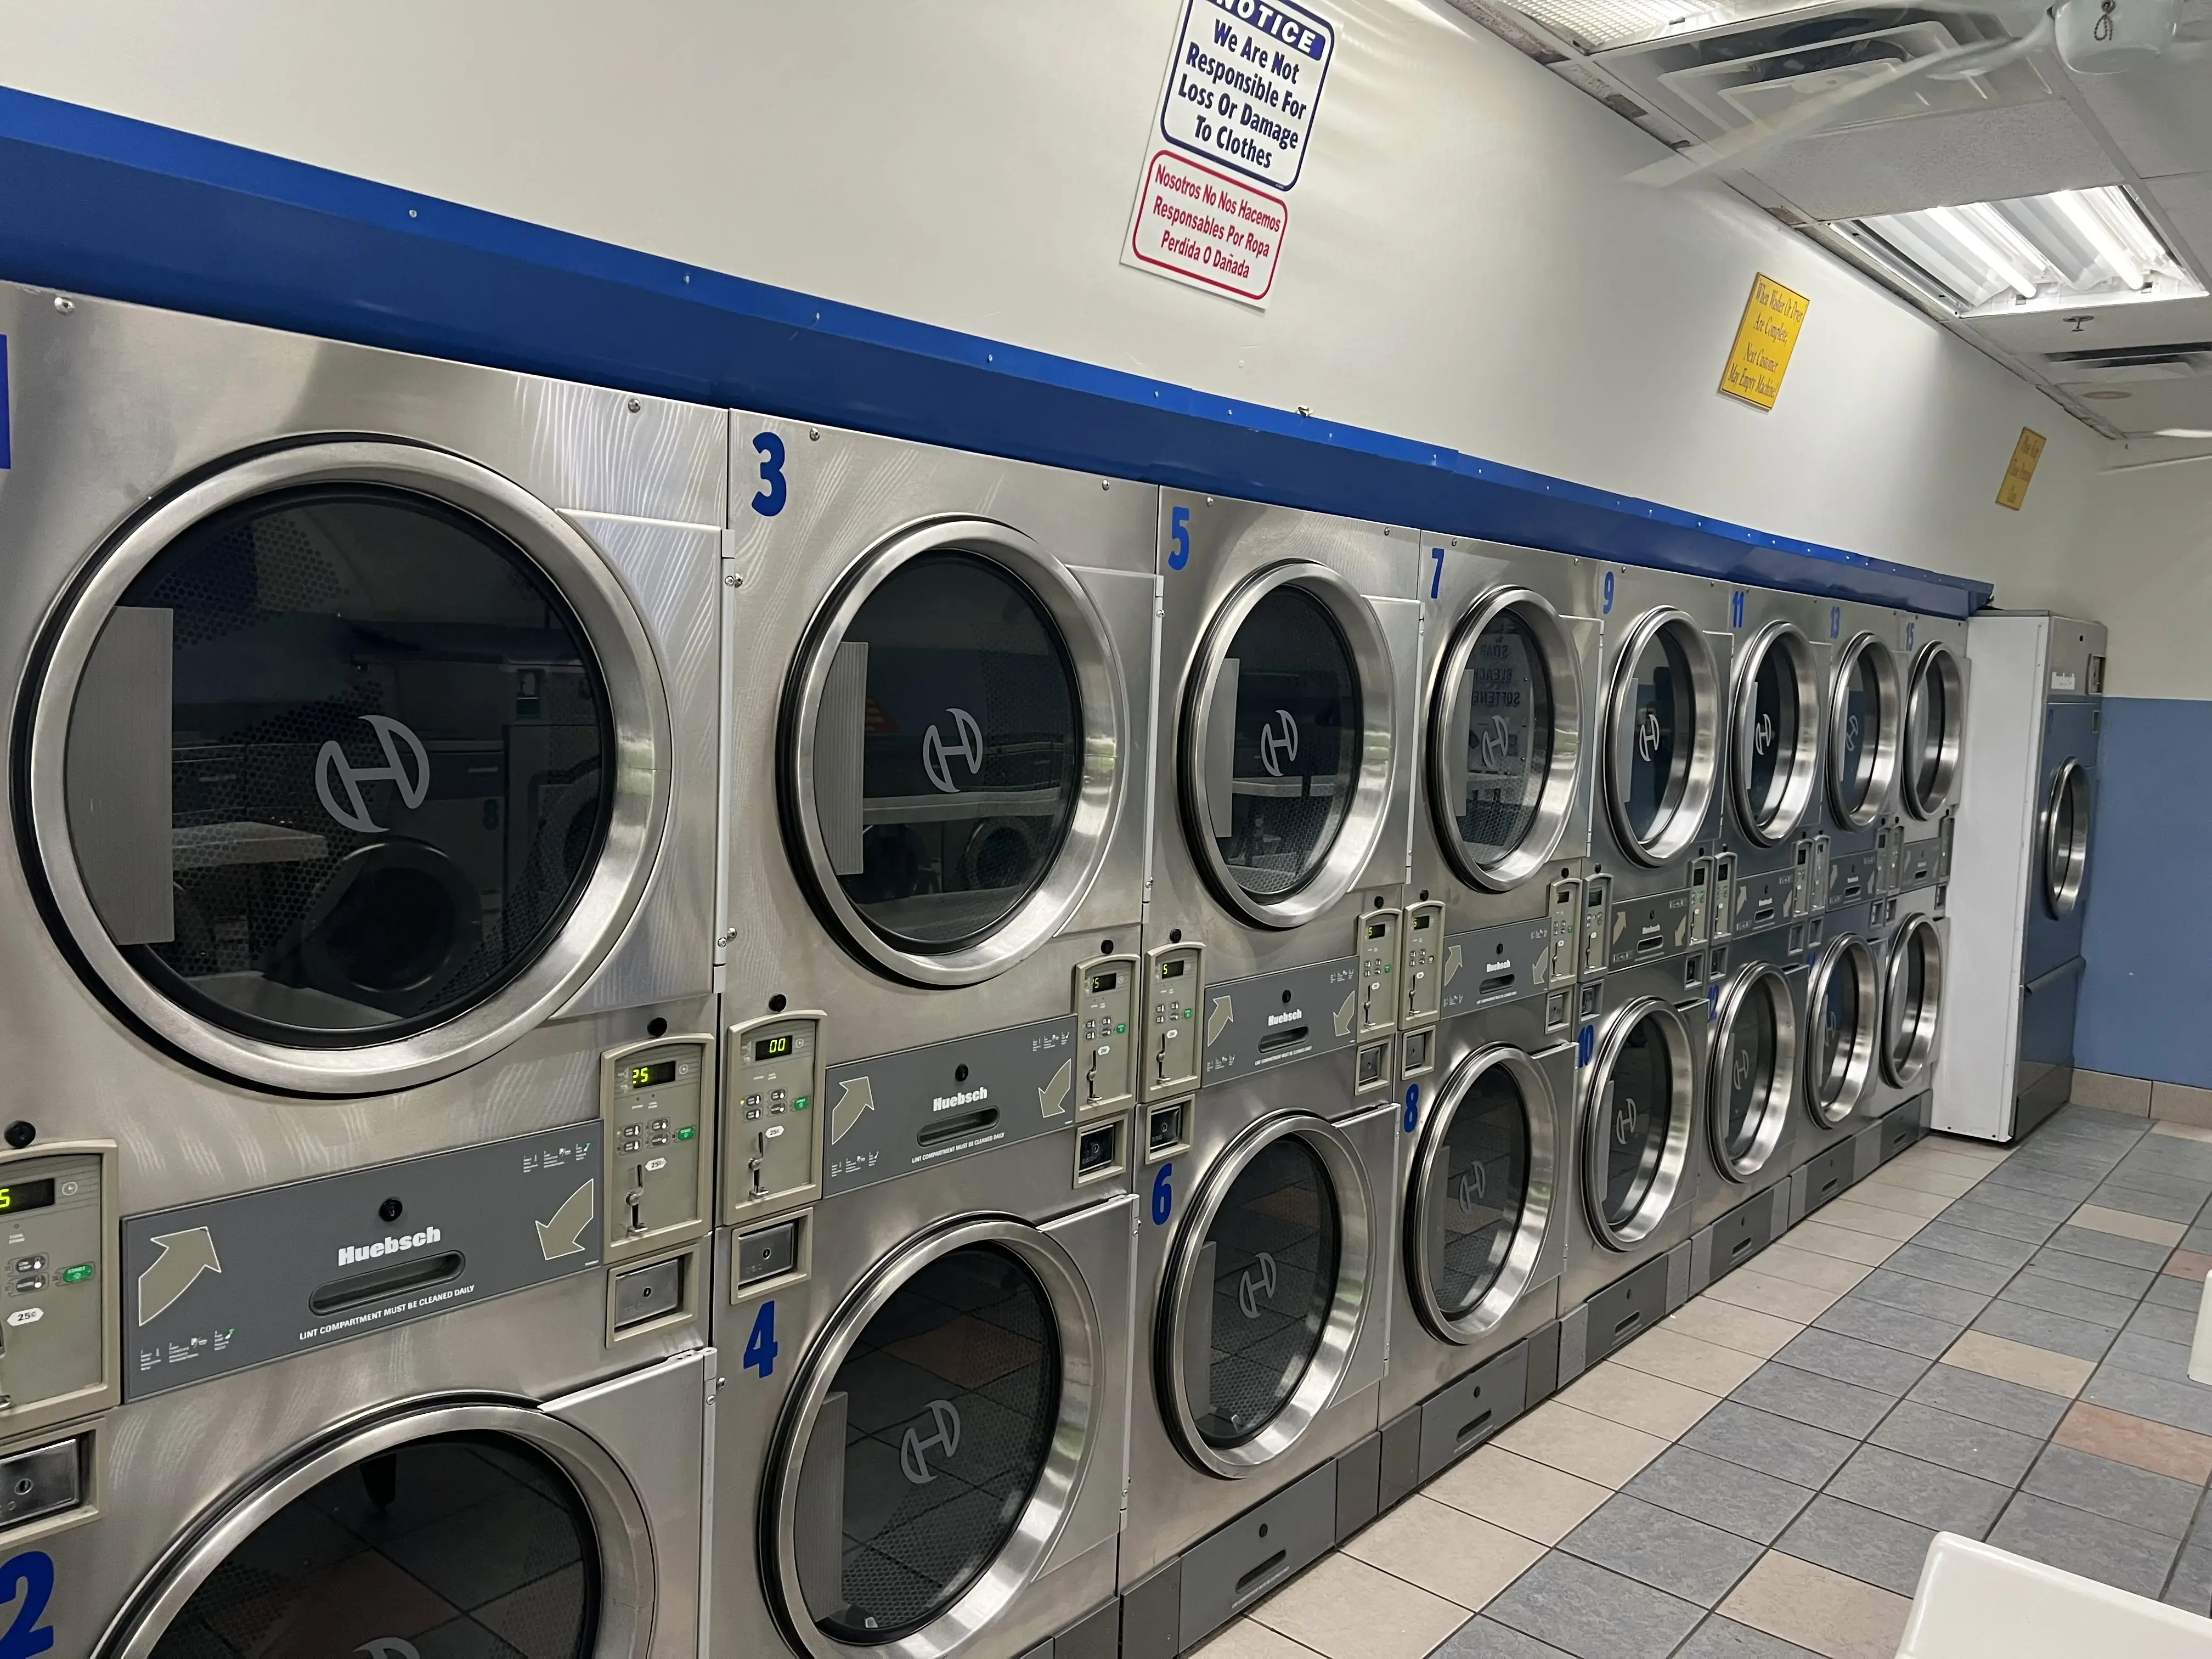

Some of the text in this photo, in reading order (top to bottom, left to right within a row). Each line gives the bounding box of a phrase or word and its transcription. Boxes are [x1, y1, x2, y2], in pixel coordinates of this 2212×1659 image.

[1214, 18, 1300, 84] We Are Not
[1186, 41, 1307, 120] Responsible For
[1178, 72, 1299, 150] Loss Or Damage
[1194, 114, 1272, 168] To Clothes
[1155, 163, 1280, 233] Nosotros No Nos Hacemos
[1153, 195, 1270, 258] Responsables Por Ropa
[1160, 229, 1250, 279] Perdida O Dañada
[1753, 311, 1765, 332] Are
[751, 432, 787, 517] 3
[1168, 506, 1190, 570] 5
[1431, 548, 1444, 599] 7
[1602, 571, 1615, 614] 9
[1732, 591, 1744, 628] 11
[1906, 622, 1915, 651] 15
[769, 1038, 786, 1053] 00
[1578, 1025, 1594, 1069] 10
[933, 1087, 988, 1111] Huebsch
[1404, 1084, 1419, 1133] 8
[912, 1155, 922, 1164] LINT
[922, 1146, 955, 1160] COMPARTMENT
[956, 1142, 968, 1151] MUST
[974, 1135, 993, 1146] CLEANED
[1152, 1163, 1173, 1226] 6
[338, 1226, 441, 1266] Huebsch
[300, 1284, 475, 1340] LINT COMPARTMENT MUST BE CLEANED DAILY
[743, 1300, 778, 1379] 4
[0, 1551, 54, 1659] 2
